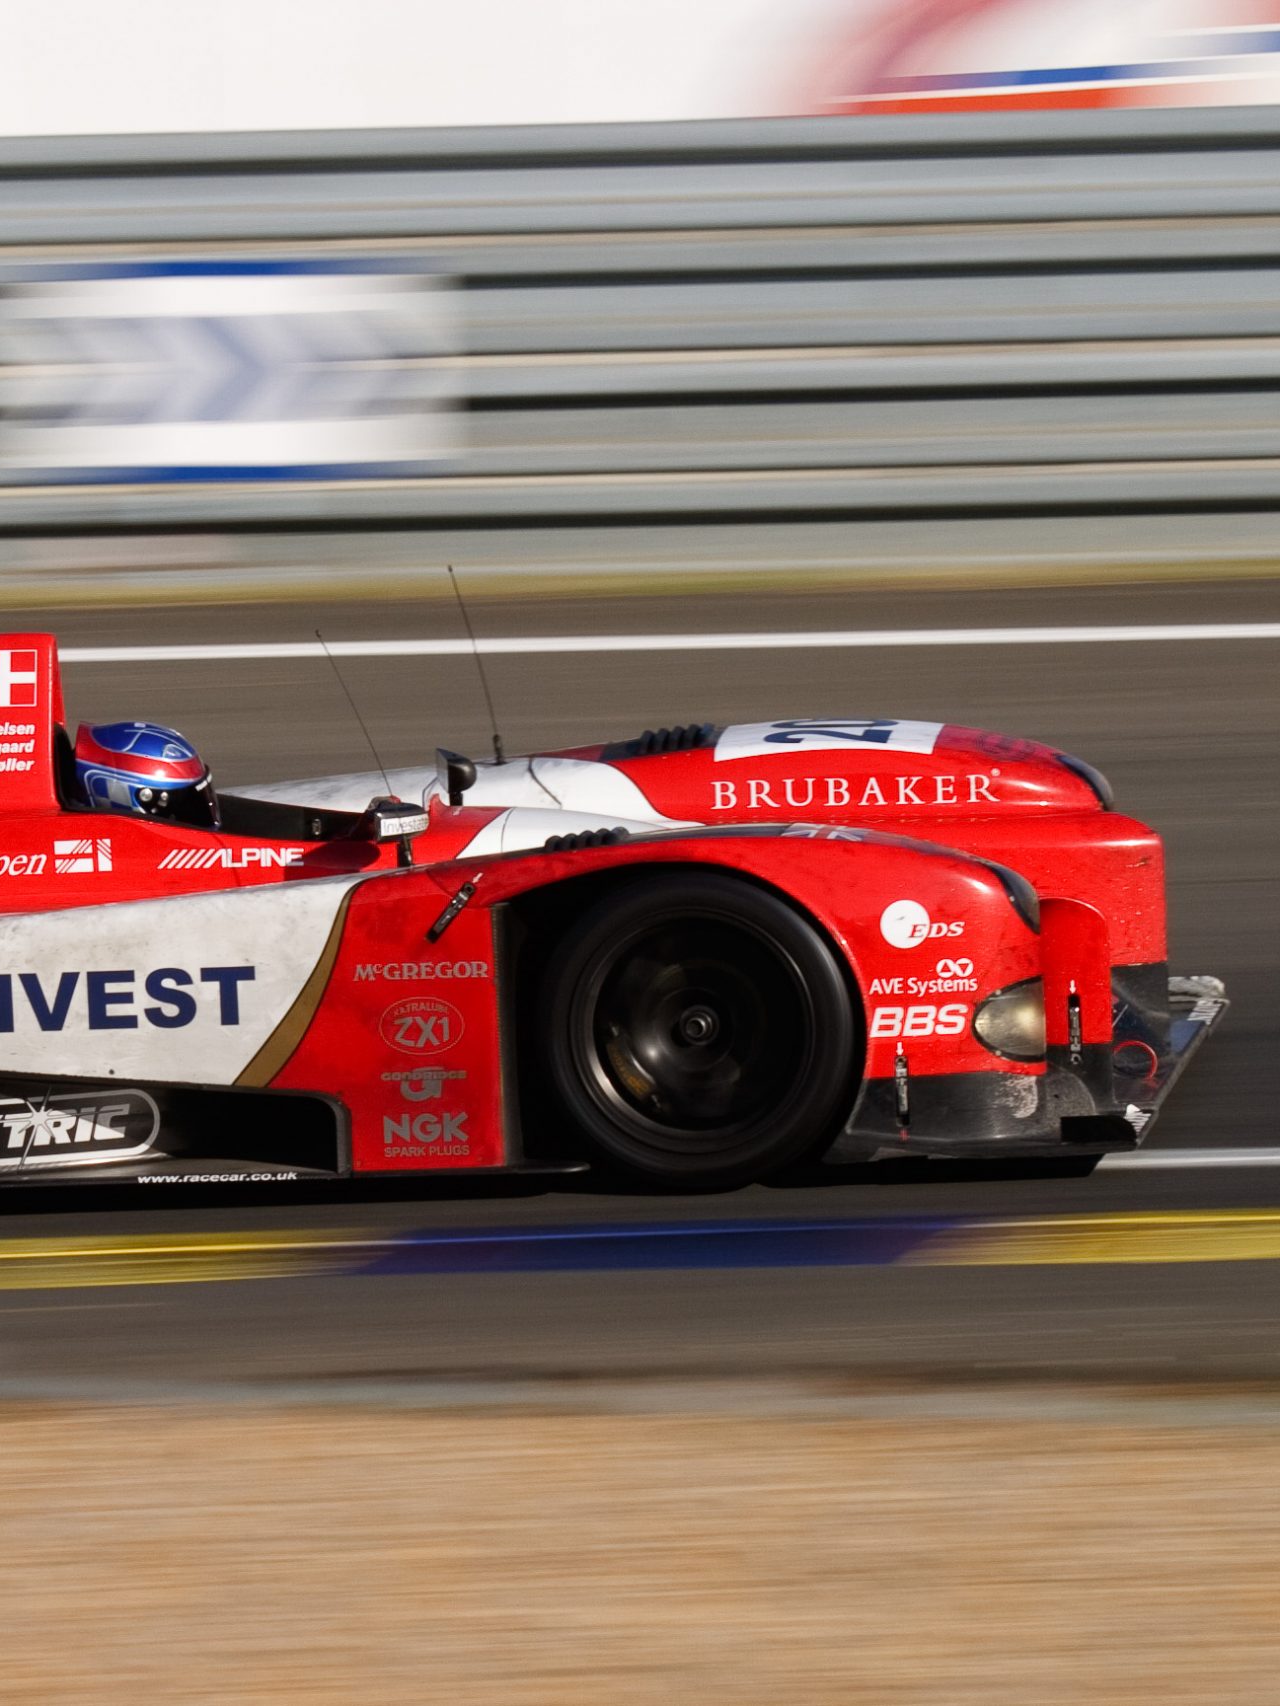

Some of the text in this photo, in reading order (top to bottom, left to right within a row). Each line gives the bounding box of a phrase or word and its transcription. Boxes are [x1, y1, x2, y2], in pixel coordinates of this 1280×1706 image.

[908, 921, 966, 938] EDS
[869, 977, 978, 997] AVE Systems
[870, 1003, 969, 1038] BBS
[394, 1016, 450, 1047] ZX1
[383, 1112, 469, 1144] NGK
[384, 1145, 470, 1158] SPARK PLUGS
[137, 1171, 298, 1184] www.racecar.co.uk
